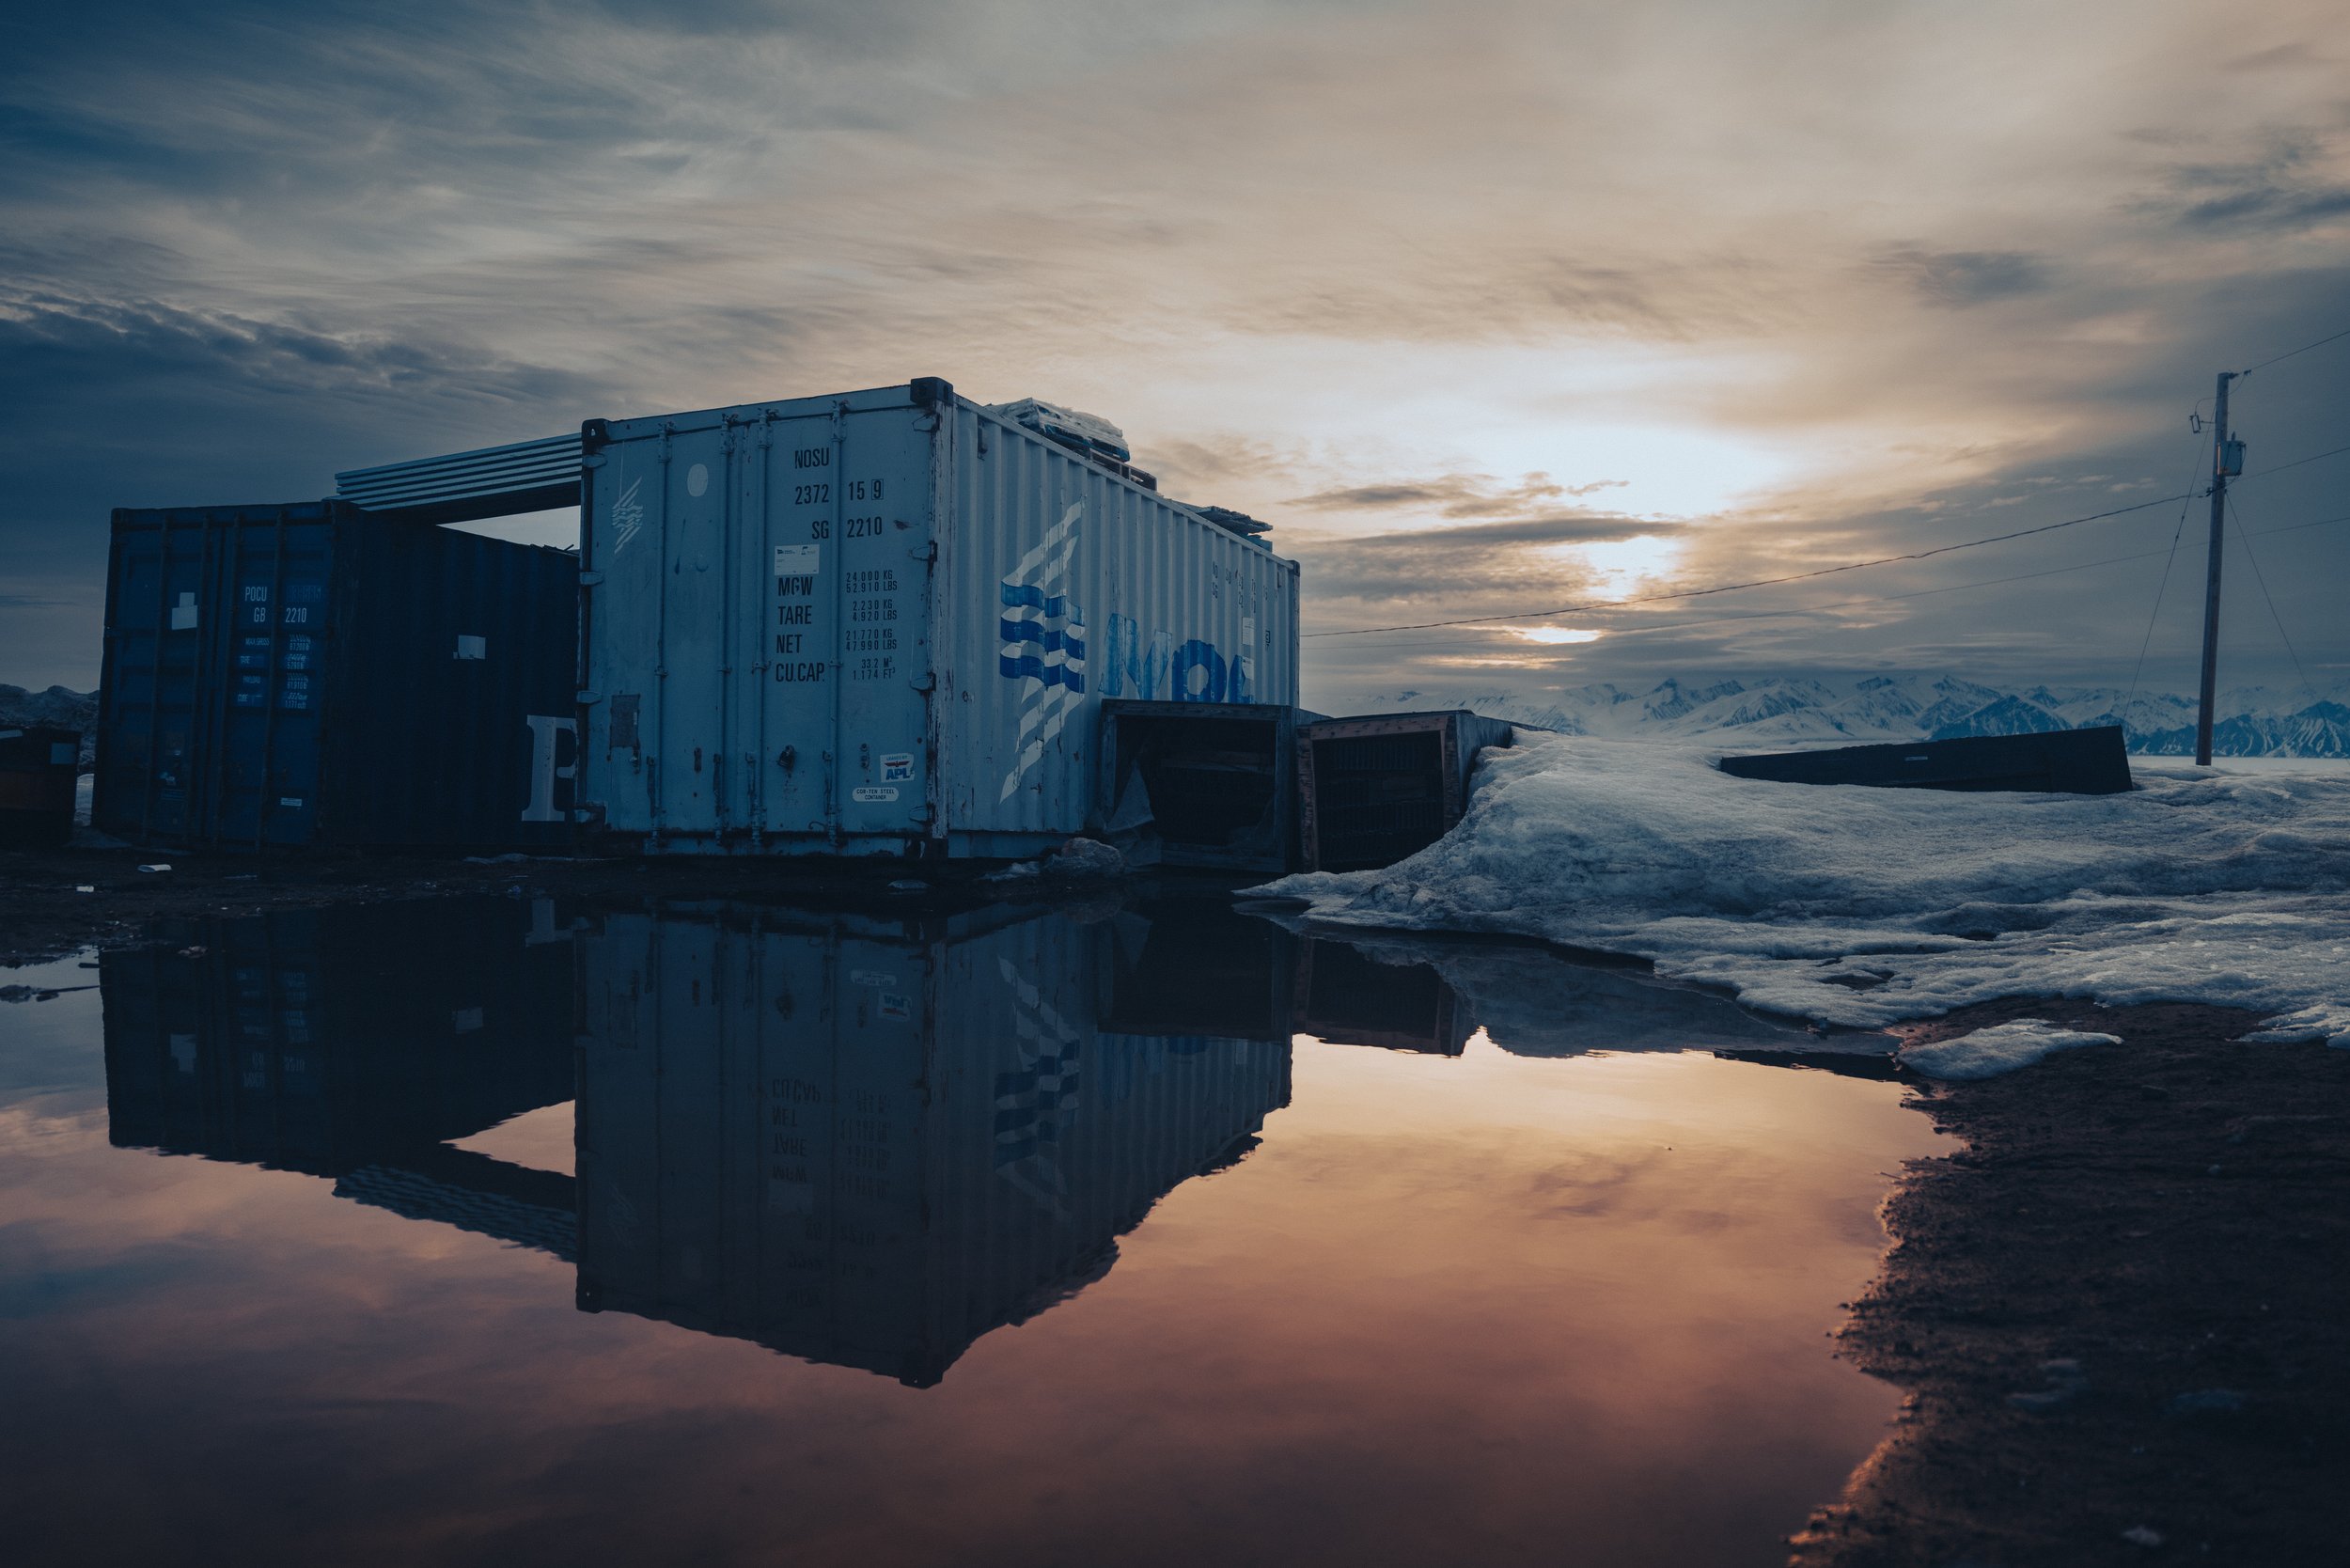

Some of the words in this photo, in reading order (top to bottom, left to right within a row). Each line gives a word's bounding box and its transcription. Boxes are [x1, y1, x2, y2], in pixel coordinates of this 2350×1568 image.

[794, 447, 830, 470] NOSU
[794, 484, 830, 505] 2372
[848, 481, 865, 500] 15
[872, 479, 882, 499] 9
[811, 520, 830, 540] SG
[846, 516, 883, 538] 2210
[846, 571, 879, 582] 24.000
[883, 570, 893, 580] KG
[777, 576, 813, 597] MGW
[846, 582, 879, 593] 52.910
[883, 581, 898, 591] LBS
[244, 586, 268, 602] POCU
[853, 600, 879, 611] 2.230
[883, 599, 893, 609] KG
[253, 607, 266, 622] GB
[285, 607, 307, 623] 2210
[777, 604, 812, 625] TARE
[853, 610, 879, 621] 4.920
[883, 610, 898, 620] LBS
[883, 629, 893, 639] KG
[776, 635, 803, 654] NET
[883, 639, 898, 650] LBS
[861, 659, 879, 669] 33.2
[776, 662, 825, 682] CU.CAP.
[853, 669, 879, 681] 1.174
[885, 768, 910, 780] APL
